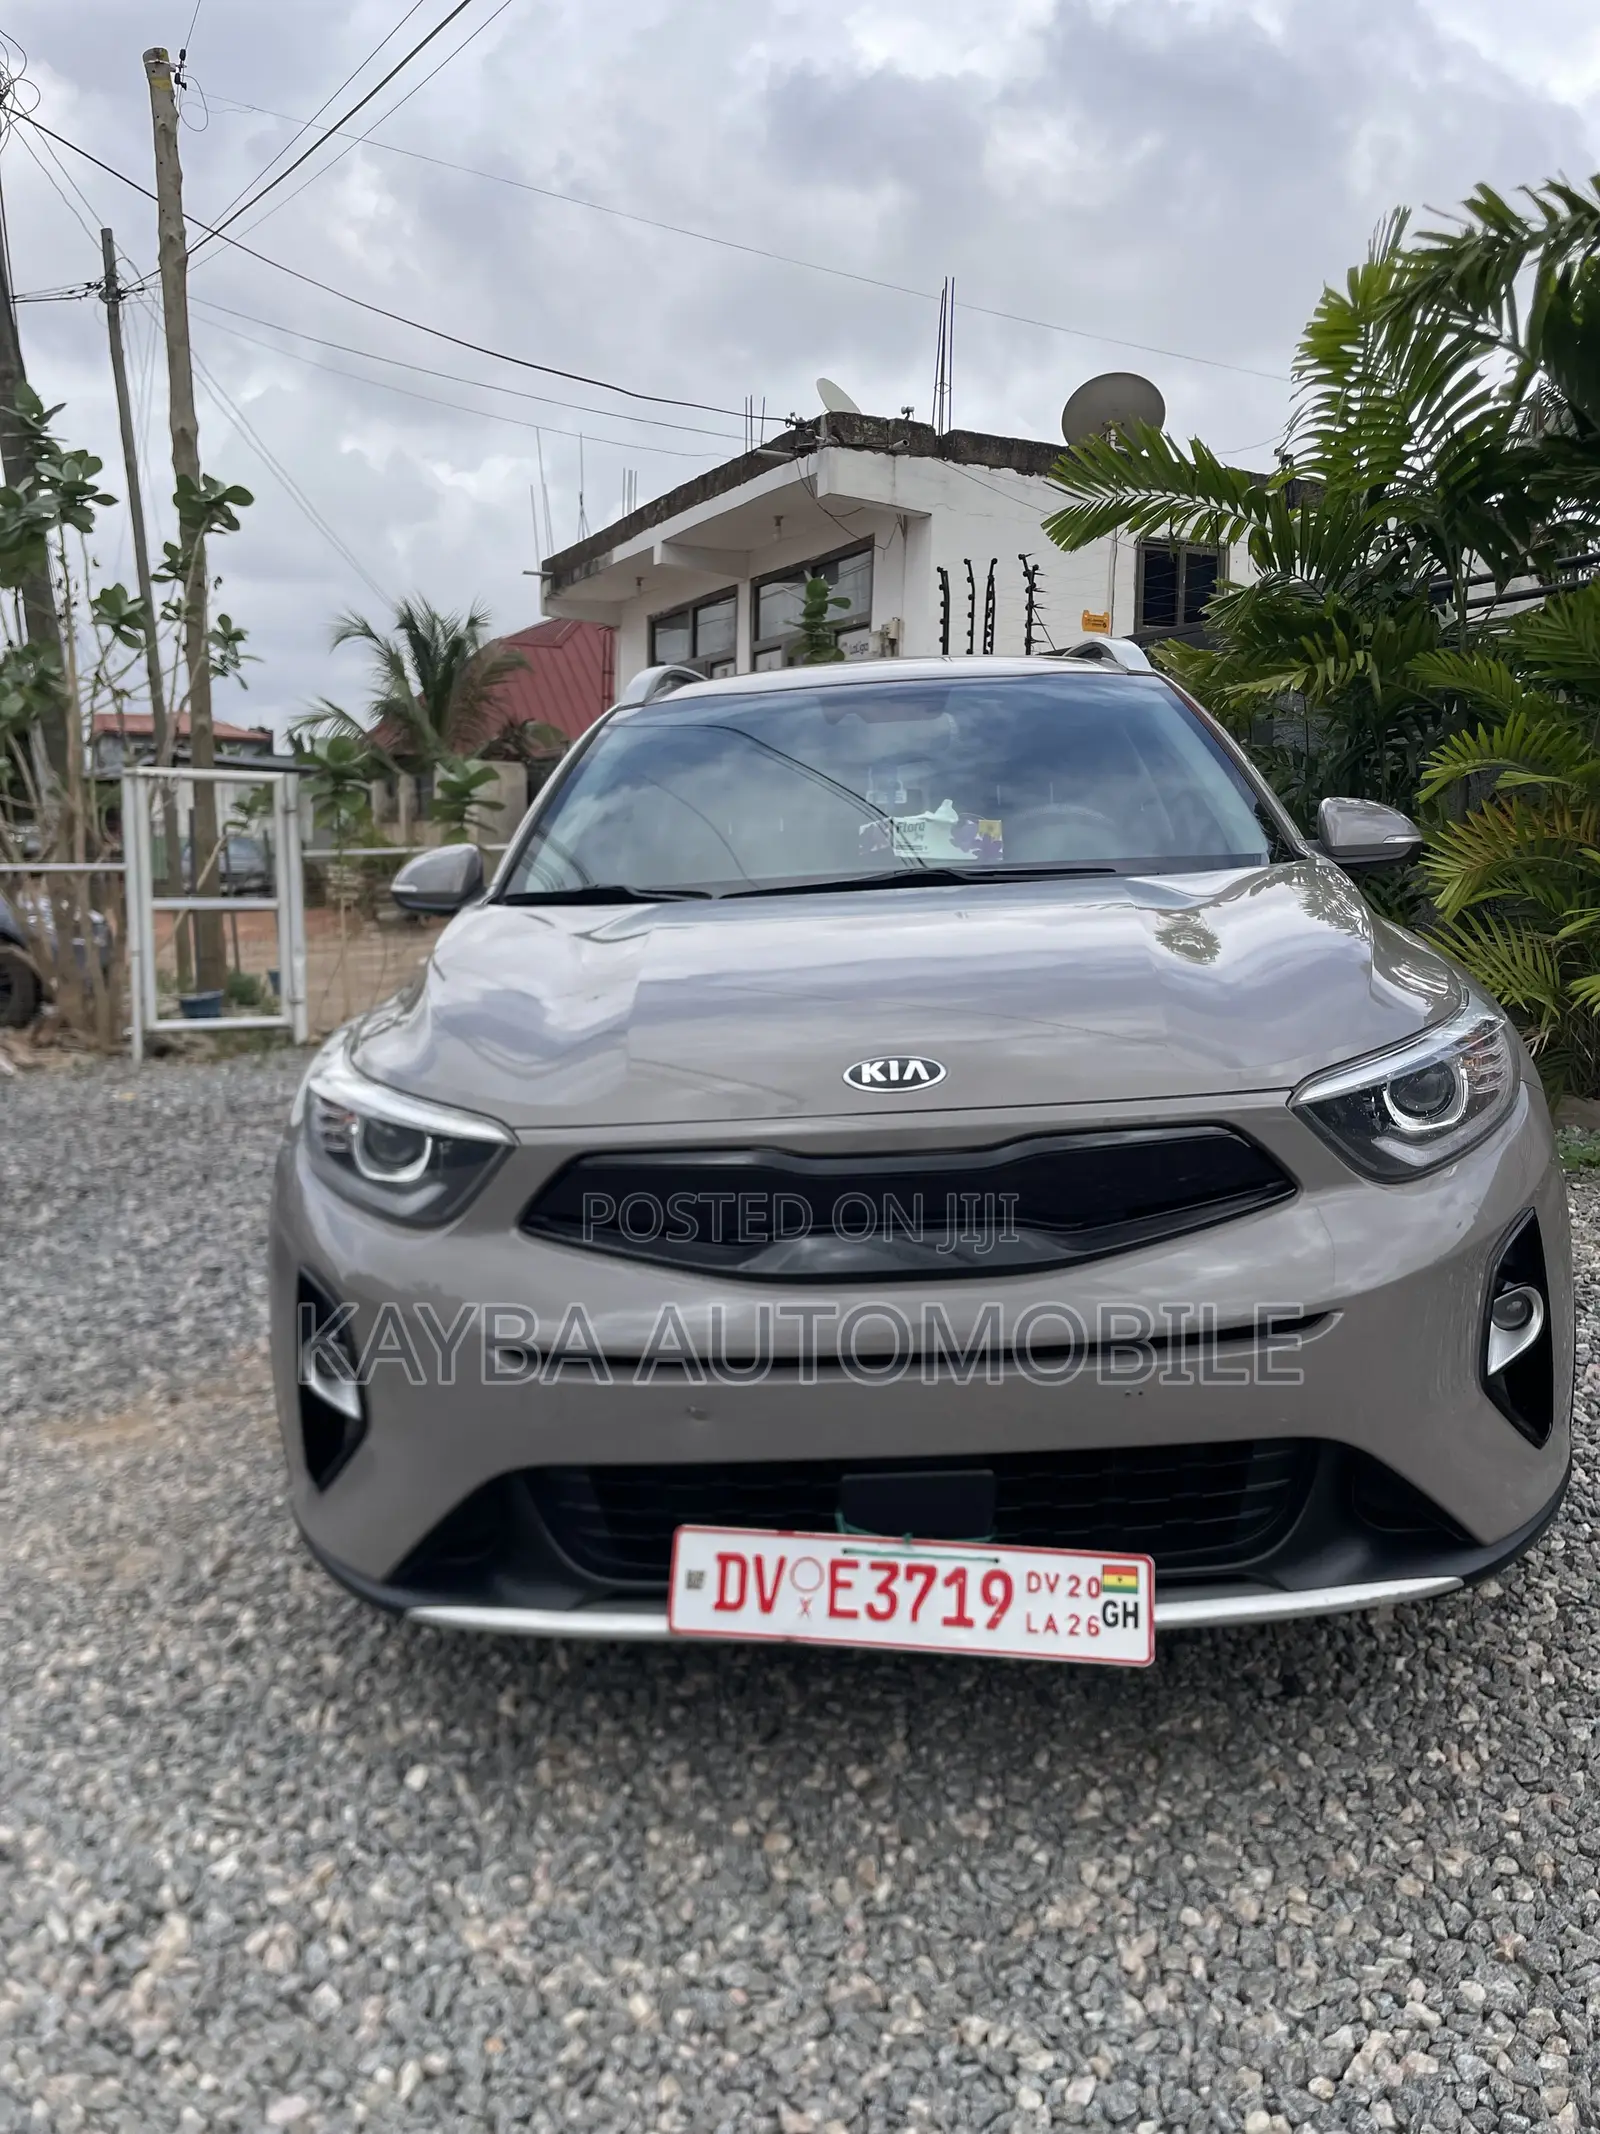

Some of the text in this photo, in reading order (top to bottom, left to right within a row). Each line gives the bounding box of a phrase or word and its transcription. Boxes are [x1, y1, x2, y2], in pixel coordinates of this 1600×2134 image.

[861, 1060, 930, 1084] KIA
[713, 1551, 1014, 1630] DV E3719
[1102, 1599, 1139, 1629] GH
